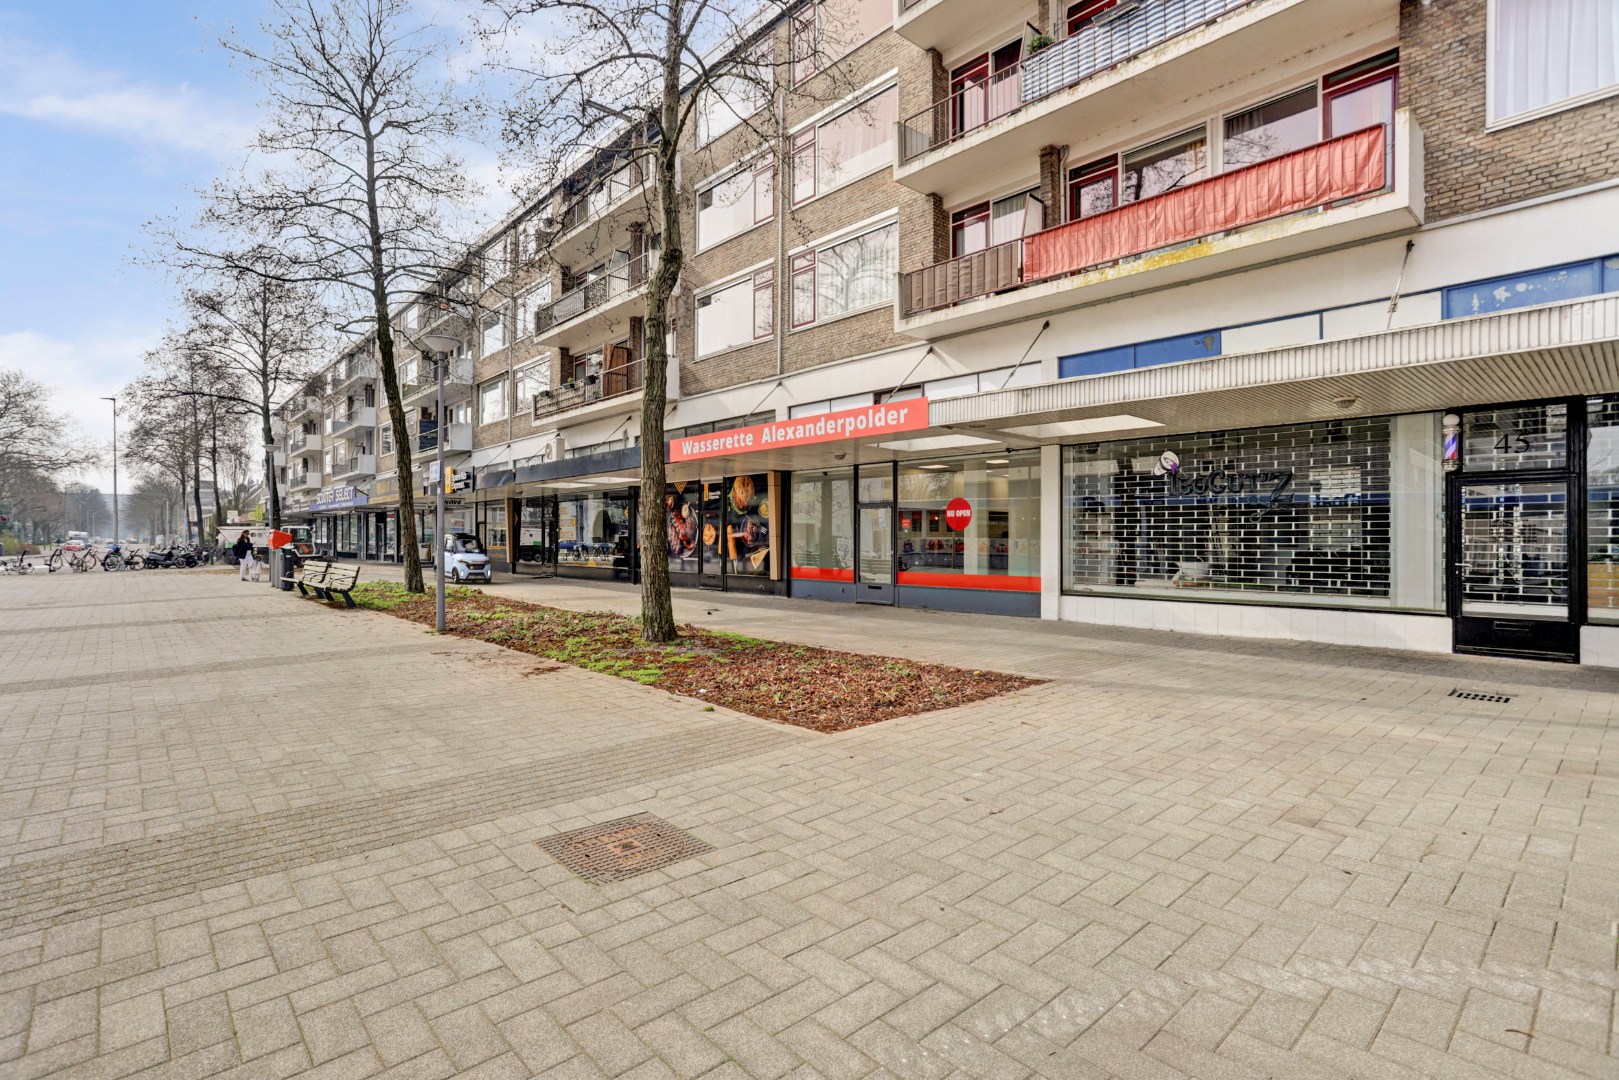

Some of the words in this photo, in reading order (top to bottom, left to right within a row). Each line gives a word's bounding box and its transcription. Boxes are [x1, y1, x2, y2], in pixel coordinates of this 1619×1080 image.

[681, 432, 754, 456] Wasserette
[761, 406, 909, 444] Alexanderpolder
[1493, 433, 1530, 454] 45
[335, 486, 355, 502] SELECT
[946, 510, 956, 518] NU
[955, 509, 971, 517] OPEN
